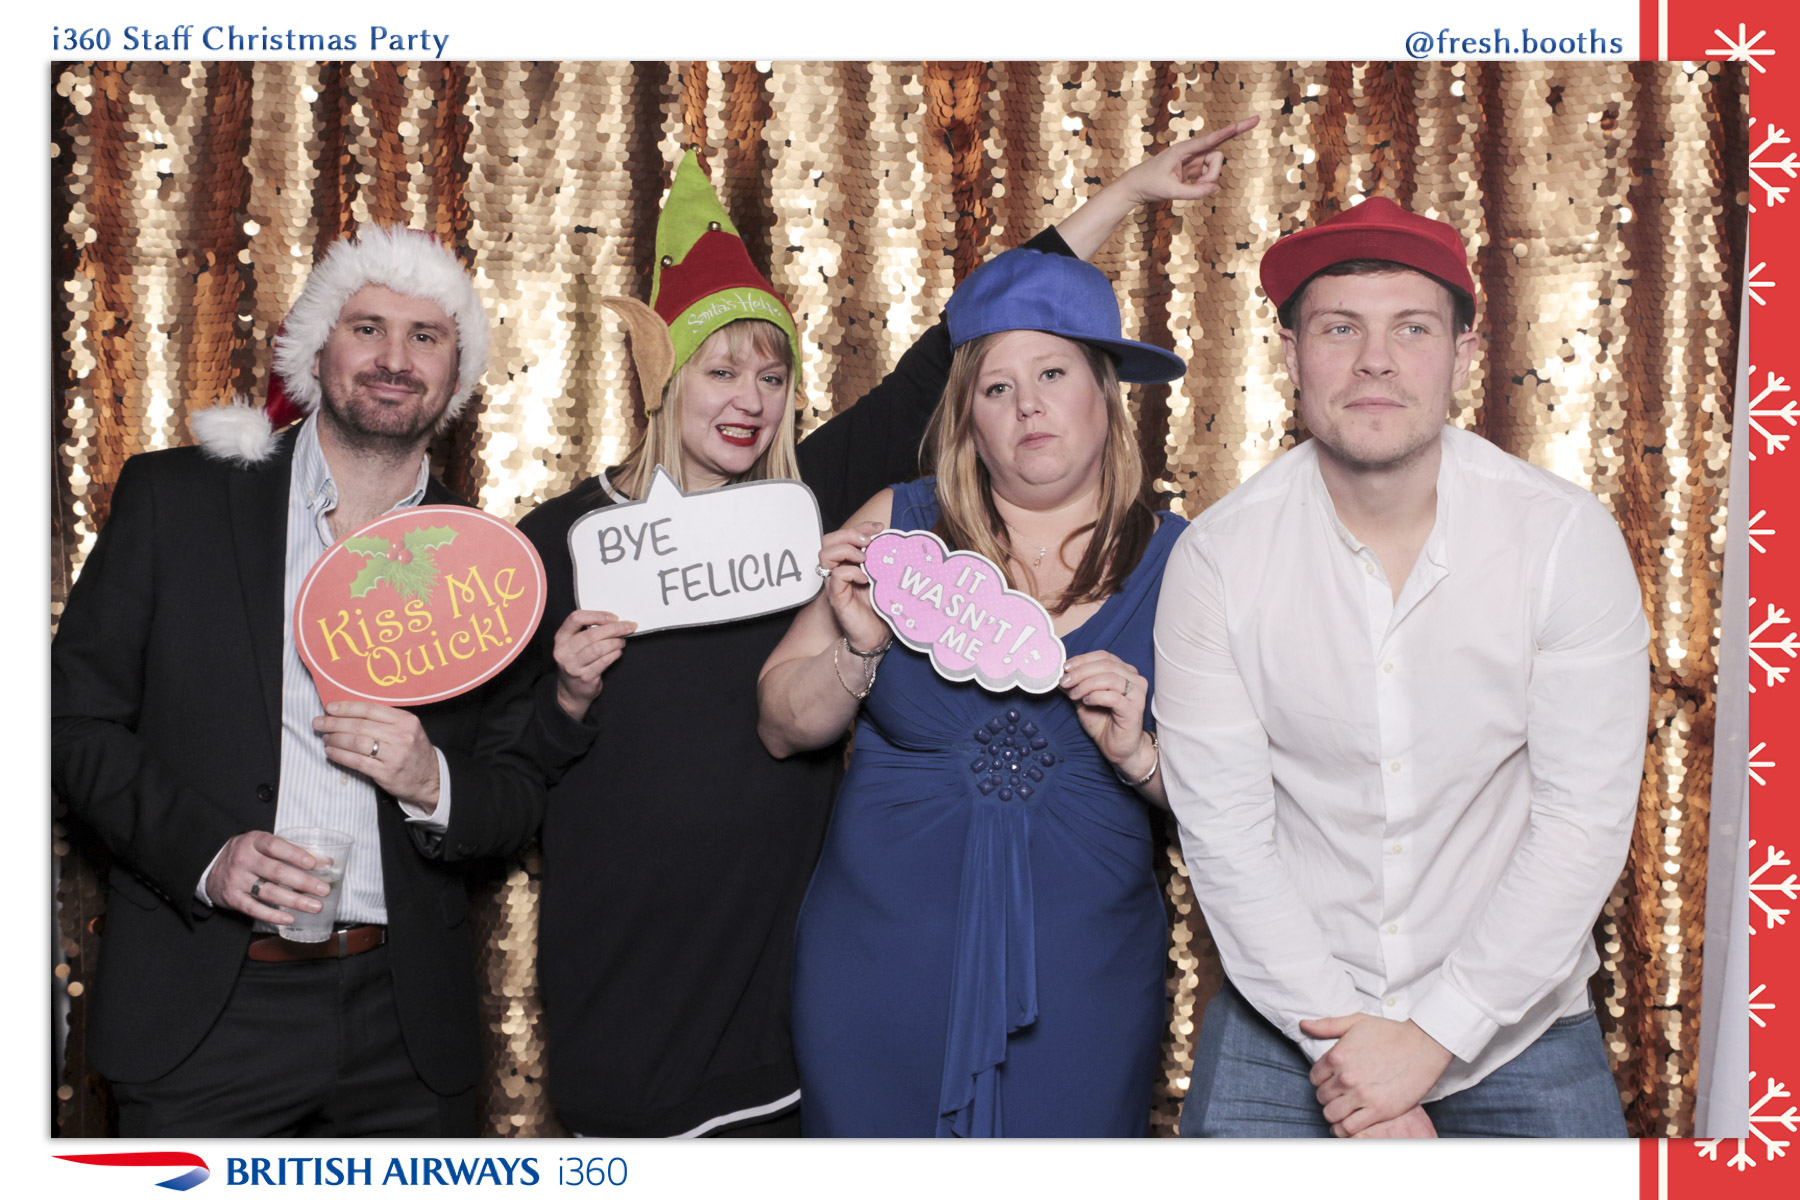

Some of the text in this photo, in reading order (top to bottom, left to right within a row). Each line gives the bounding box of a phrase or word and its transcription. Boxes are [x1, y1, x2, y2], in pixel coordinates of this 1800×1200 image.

[687, 292, 782, 325] Santa's Help
[598, 517, 678, 565] BYE
[657, 549, 802, 605] FELICIA
[955, 565, 988, 595] IT
[317, 565, 525, 662] Kiss Me
[900, 565, 1013, 644] WASN'T
[366, 605, 513, 686] Quick!
[938, 624, 985, 662] ME
